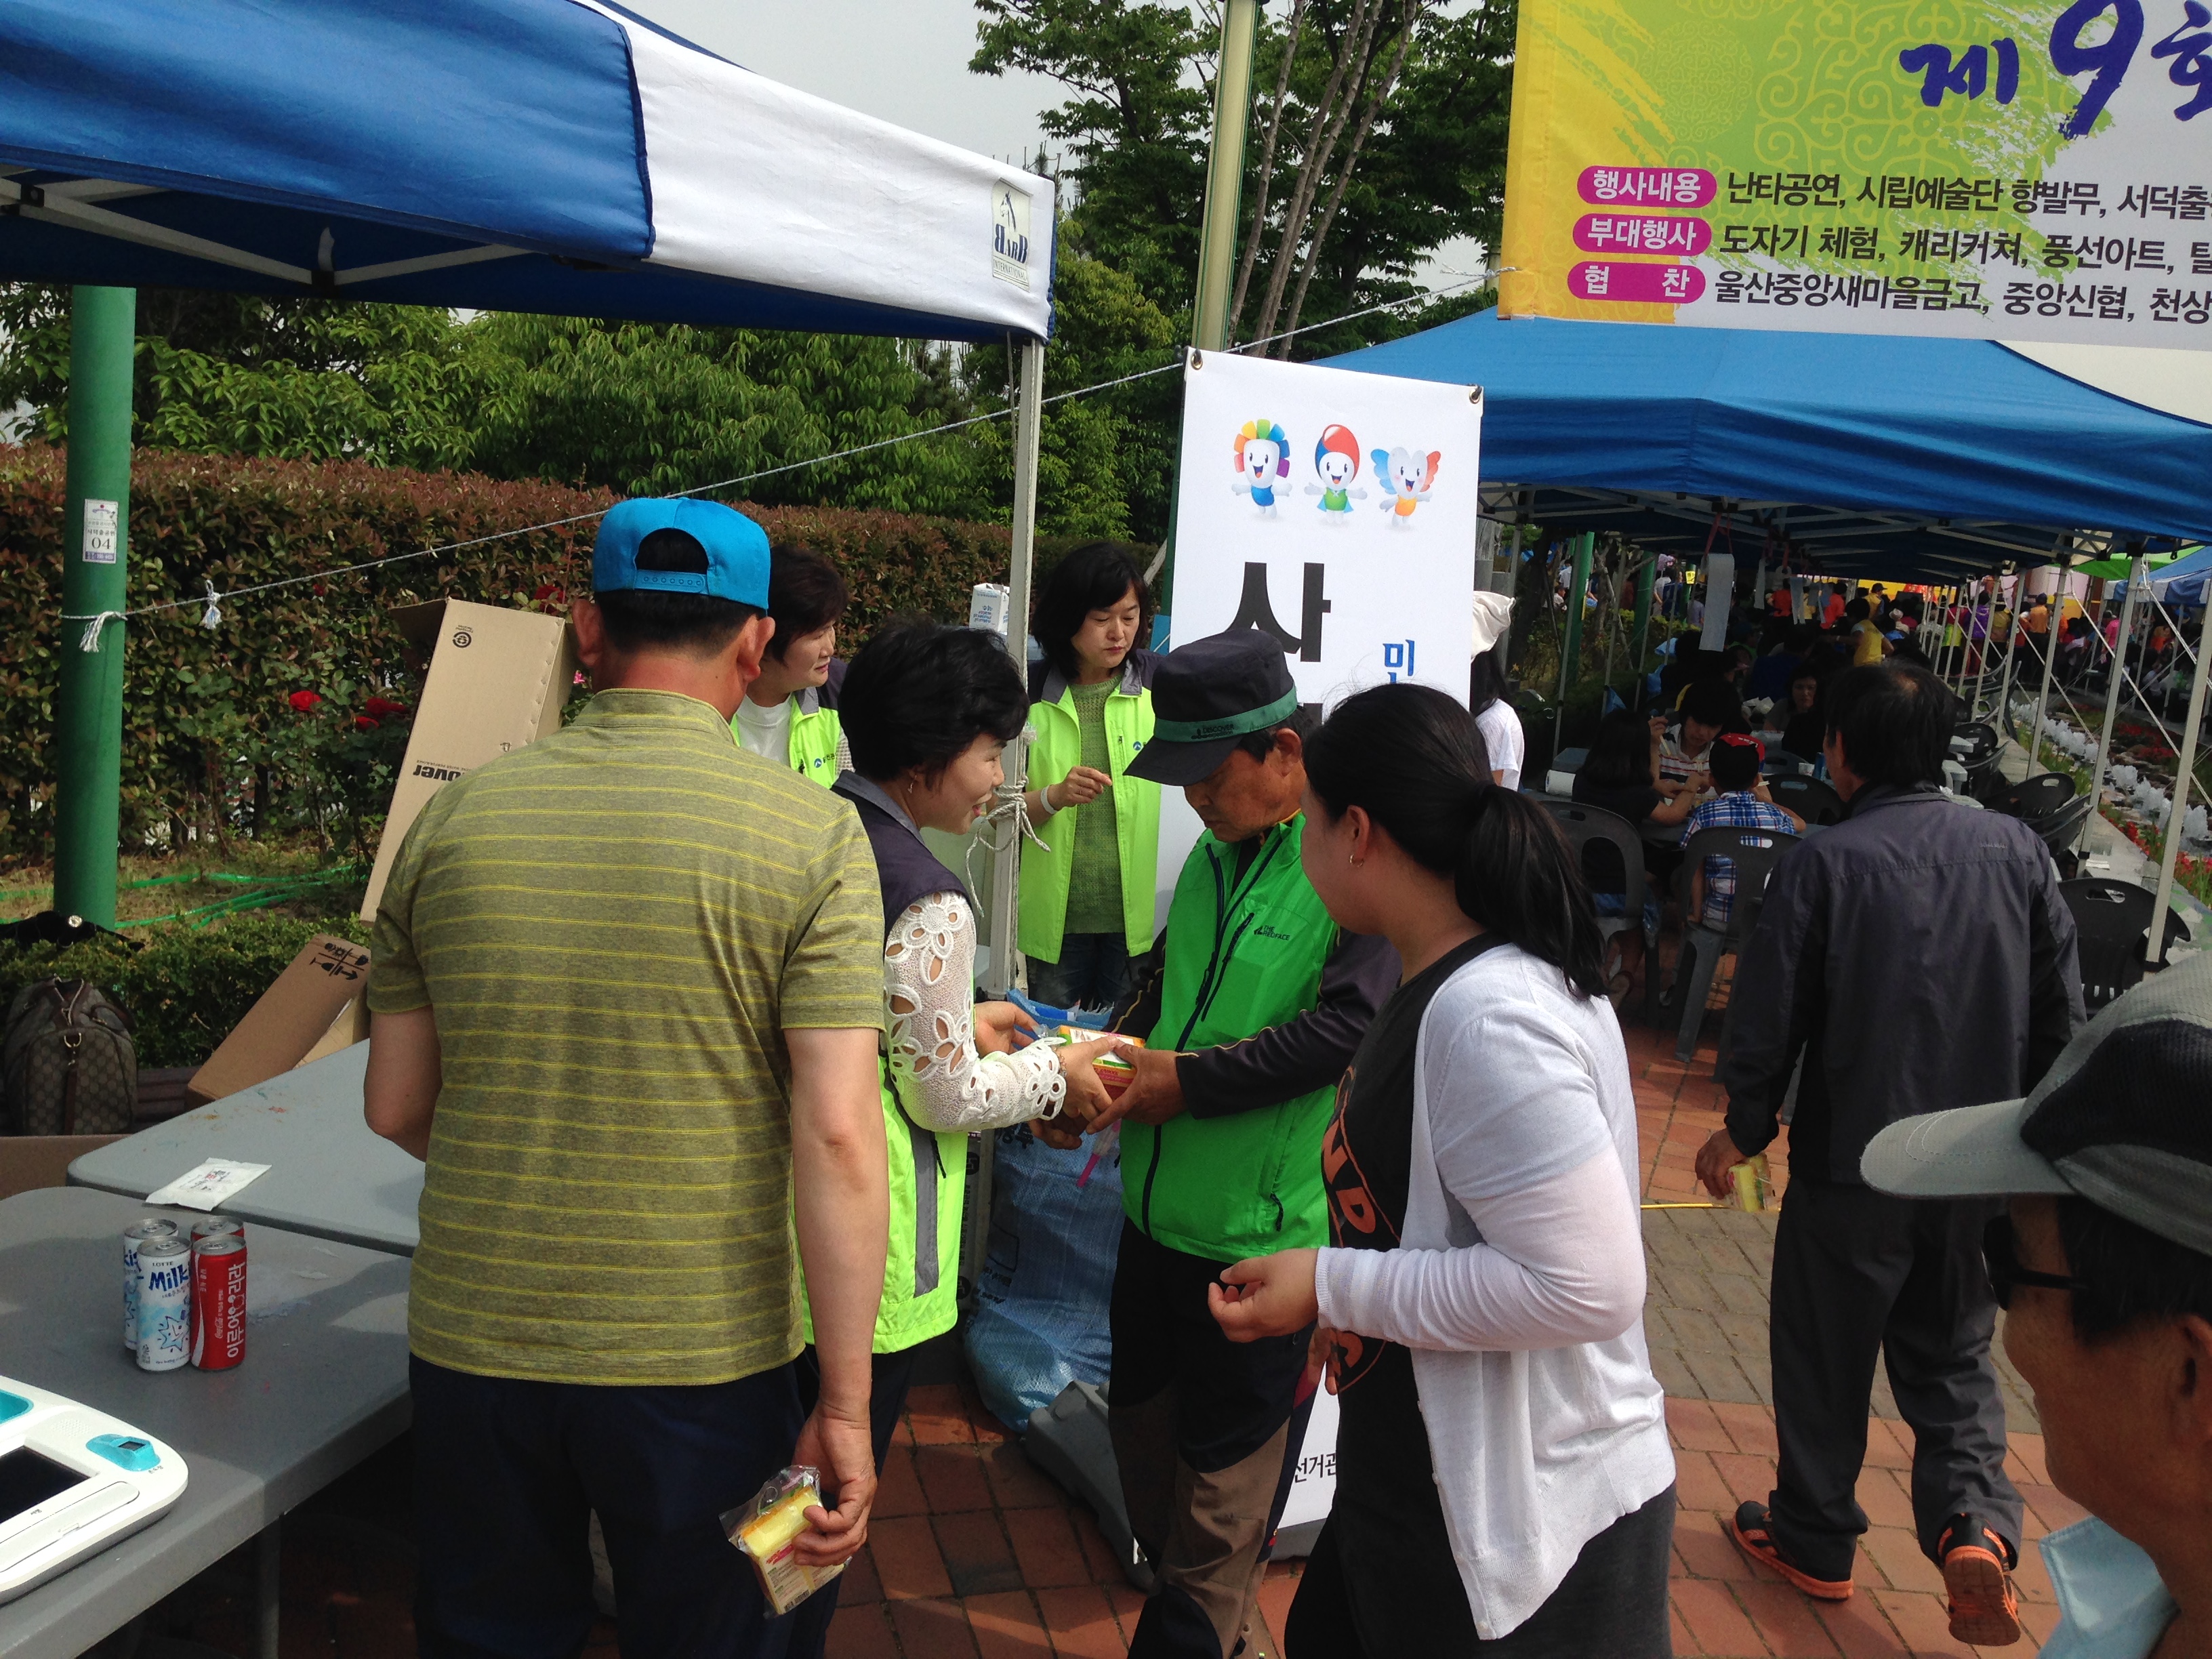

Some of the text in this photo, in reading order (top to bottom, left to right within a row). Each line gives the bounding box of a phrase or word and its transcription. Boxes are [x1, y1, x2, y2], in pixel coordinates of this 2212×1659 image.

[1593, 169, 1702, 203] 행사내용
[1727, 172, 2212, 221] 난타공연, 시립예술단 향발무, 서덕출
[1587, 218, 1696, 251] 부대행사
[1719, 224, 1807, 258] 도자기
[1818, 226, 1885, 262] 체험,
[1898, 229, 2028, 268] 캐리커쳐,
[2042, 234, 2173, 275] 풍선아트,
[994, 259, 1028, 281] INTERNATIONAL
[1584, 265, 1689, 298] 협 찬
[1715, 270, 1990, 314] 울산중앙새마을금고,
[2003, 282, 2135, 322] 중앙신협,
[91, 537, 111, 550] 04
[413, 765, 465, 781] over
[148, 1264, 190, 1291] Milk
